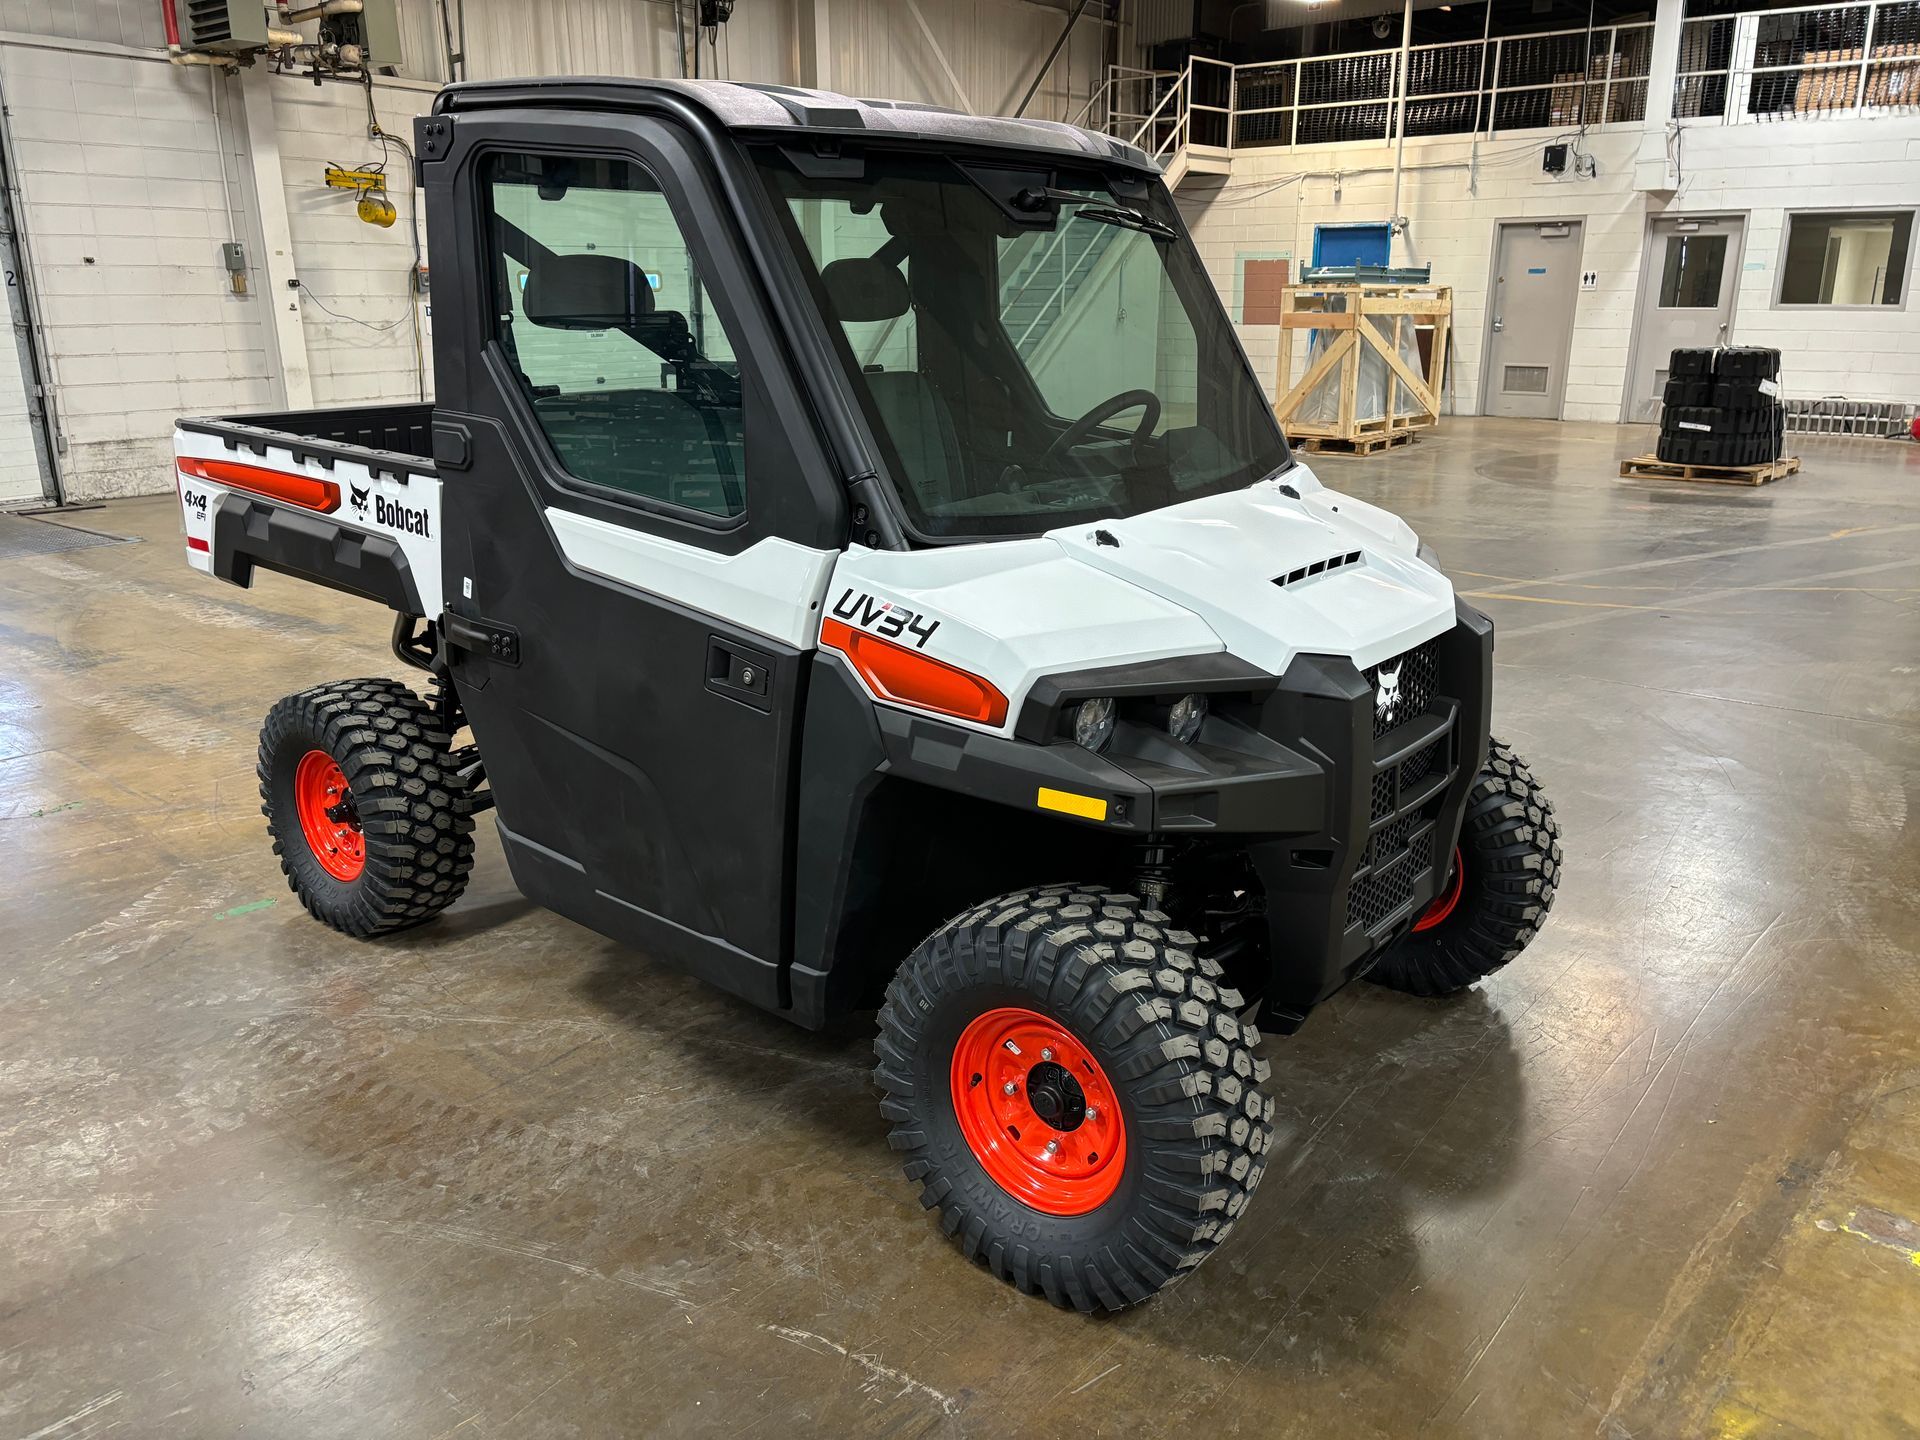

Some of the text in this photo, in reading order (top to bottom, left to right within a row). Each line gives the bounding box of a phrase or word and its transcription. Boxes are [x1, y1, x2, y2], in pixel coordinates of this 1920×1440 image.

[5, 270, 17, 287] 2
[184, 490, 207, 512] 4x4
[196, 511, 207, 522] EFI
[375, 494, 430, 538] Bobcat
[832, 588, 941, 649] UV34
